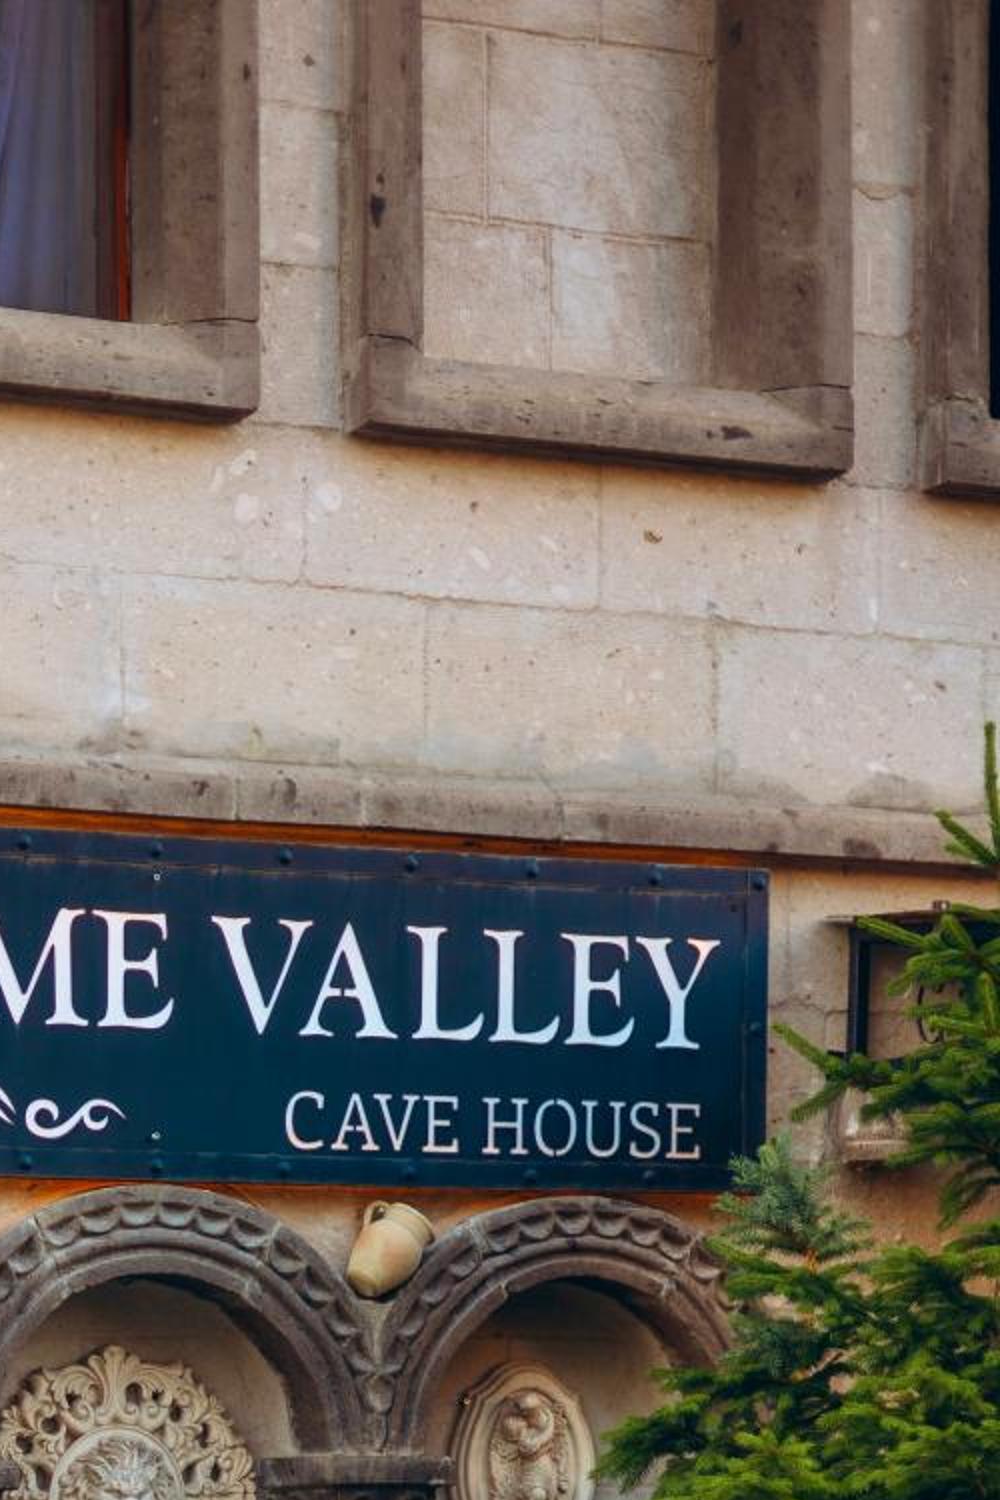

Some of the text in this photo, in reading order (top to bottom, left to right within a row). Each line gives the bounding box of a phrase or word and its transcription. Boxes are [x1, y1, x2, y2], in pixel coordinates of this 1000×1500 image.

[210, 914, 722, 1051] VALLEY
[284, 1090, 702, 1160] CAVE HOUSE
